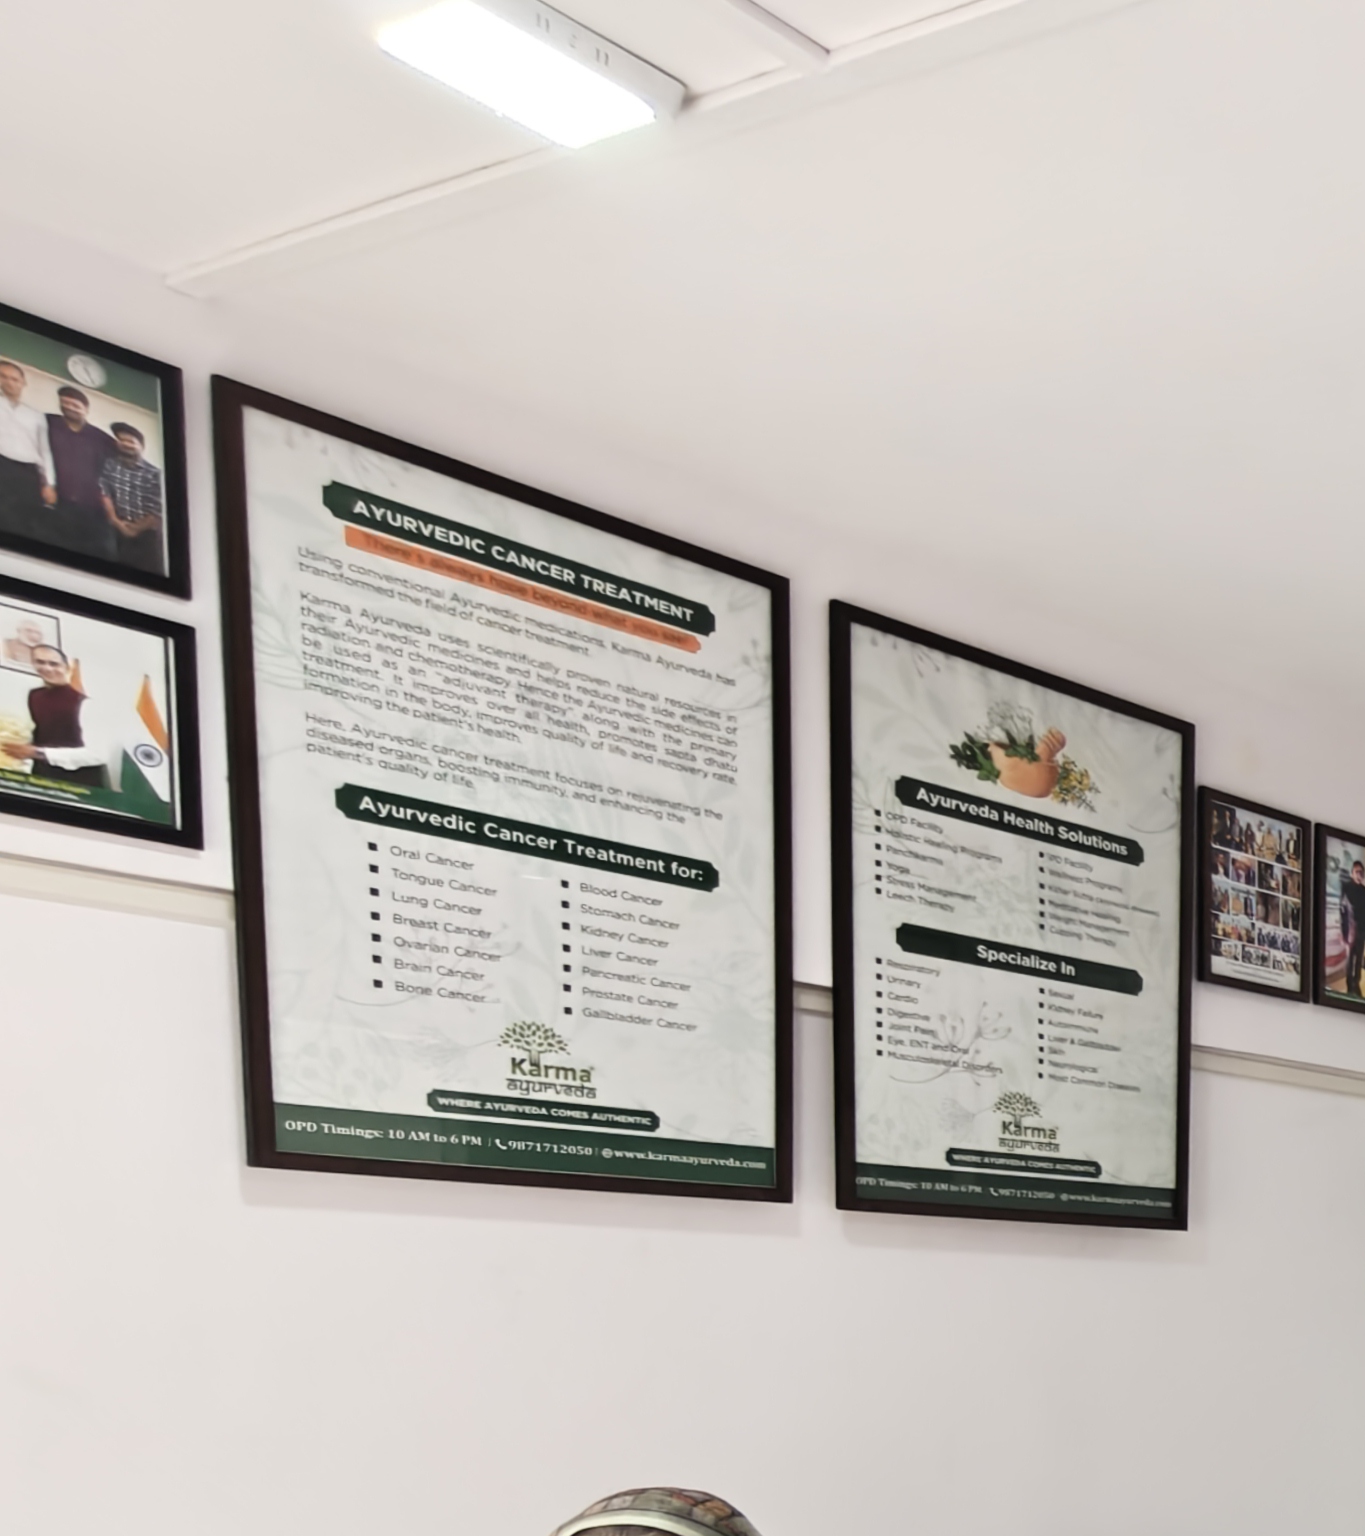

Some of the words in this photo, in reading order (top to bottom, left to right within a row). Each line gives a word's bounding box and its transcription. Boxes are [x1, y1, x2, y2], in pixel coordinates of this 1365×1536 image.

[352, 497, 486, 556] AYURVEDIC
[490, 543, 576, 585] CANCER
[580, 573, 694, 623] TREATMENT
[297, 545, 343, 572] Using
[347, 560, 445, 600] conventional
[449, 591, 521, 625] Ayurvedic
[611, 640, 652, 662] Karma
[655, 654, 712, 682] Ayurveda
[715, 672, 736, 687] has
[299, 589, 351, 615] Karma
[359, 606, 431, 640] Ayurveda
[437, 631, 470, 649] uses
[476, 640, 560, 676] scientifically
[566, 668, 610, 690] proven
[615, 681, 659, 703] natural
[663, 696, 721, 720] resources
[726, 712, 737, 725] in
[302, 679, 382, 711] improving
[386, 700, 410, 716] the
[302, 664, 380, 695] formation
[384, 685, 398, 699] in
[403, 690, 427, 707] the
[476, 710, 538, 736] improves
[542, 727, 585, 748] quality
[590, 738, 604, 752] of
[607, 743, 627, 758] life
[630, 749, 654, 764] and
[656, 757, 708, 779] recovery
[305, 726, 374, 753] diseased
[437, 757, 500, 783] boosting
[571, 789, 596, 804] and
[599, 795, 663, 821] enhancing
[666, 811, 686, 825] the
[350, 722, 428, 753] Ayurvedic
[431, 743, 478, 764] cancer
[483, 754, 551, 781] treatment
[554, 772, 603, 793] focuses
[606, 785, 623, 798] on
[626, 789, 701, 817] rejuvenating
[703, 807, 723, 821] the
[377, 756, 429, 780] quality
[432, 769, 448, 784] of
[916, 785, 999, 824] Ayurveda
[1003, 809, 1054, 837] Health
[1057, 824, 1128, 857] Solutions
[358, 793, 477, 837] Ayurvedic
[482, 820, 557, 852] Cancer
[562, 837, 666, 874] Treatment
[670, 860, 703, 882] for:
[389, 844, 421, 861] Oral
[424, 851, 475, 871] Cancer
[390, 867, 444, 889] Tongue
[448, 878, 497, 898] Cancer
[579, 881, 617, 899] Blood
[620, 889, 663, 907] Cancer
[391, 890, 428, 909] Lung
[432, 897, 482, 917] Cancer
[579, 902, 635, 923] Stomach
[638, 913, 680, 931] Cancer
[392, 912, 438, 931] Breast
[443, 921, 492, 940] Cancer
[580, 923, 625, 943] Kidney
[627, 932, 669, 949] Cancer
[392, 935, 449, 955] Ovarian
[453, 944, 502, 963] Cancer
[580, 944, 612, 960] Liver
[616, 950, 659, 967] Cancer
[976, 943, 1057, 975] Specialize
[1060, 960, 1076, 977] In
[393, 957, 432, 974] Brain
[435, 963, 485, 982] Cancer
[581, 965, 646, 985] Pancreatic
[649, 976, 691, 992] Cancer
[394, 980, 432, 996] Bone
[436, 986, 487, 1003] Cancer
[581, 986, 633, 1004] Prostate
[637, 994, 678, 1010] Cancer
[581, 1006, 653, 1026] Gallbladder
[655, 1016, 697, 1032] Cancer
[510, 1056, 592, 1083] Karma
[505, 1076, 597, 1102] ayurveda
[436, 1096, 482, 1109] WHERE
[483, 1101, 549, 1116] AYURVEDA
[550, 1107, 588, 1120] COMES
[591, 1111, 652, 1126] AUTHENTIC
[284, 1119, 318, 1133] OPD
[387, 1128, 405, 1140] 10
[407, 1129, 431, 1142] AM
[433, 1132, 448, 1143] to
[449, 1133, 459, 1144] 6
[464, 1134, 482, 1146] PM
[1001, 1119, 1057, 1140] Karma
